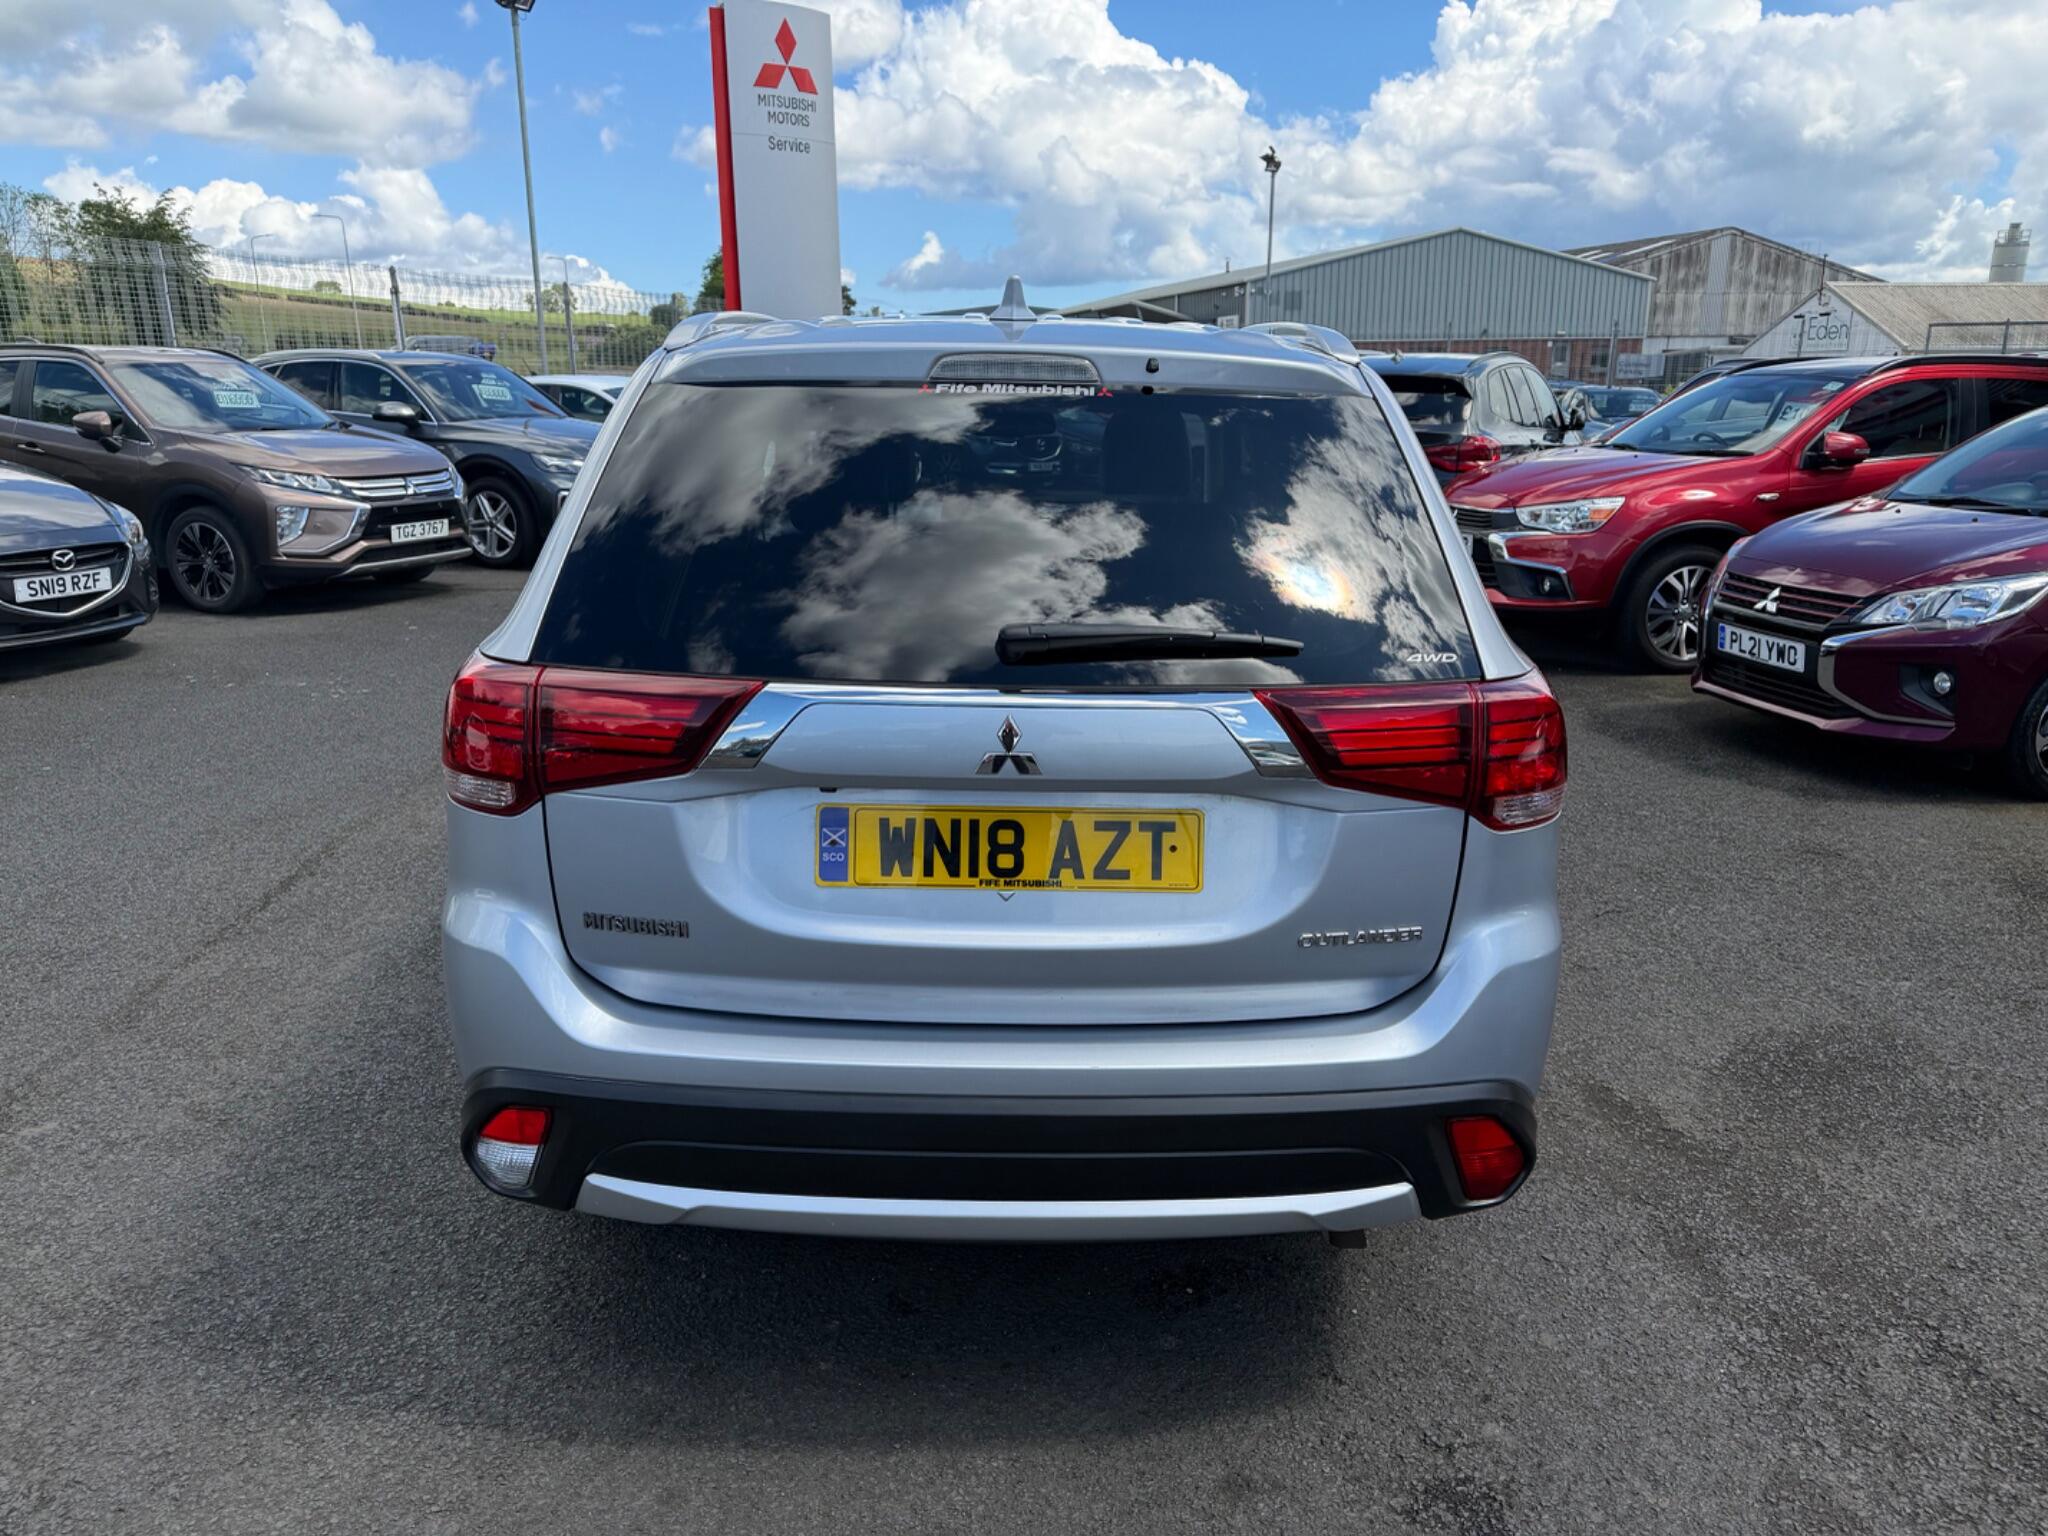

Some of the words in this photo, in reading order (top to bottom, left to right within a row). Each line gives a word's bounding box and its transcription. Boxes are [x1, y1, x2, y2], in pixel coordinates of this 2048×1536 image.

[757, 94, 817, 112] MITSUBISHI
[767, 111, 810, 127] MOTORS
[768, 135, 811, 154] Service
[1807, 314, 1851, 341] Eden
[981, 383, 1096, 397] Mitsubishi
[396, 524, 417, 539] TGZ
[419, 520, 444, 536] 3767
[26, 577, 67, 598] SN19
[71, 571, 101, 592] RZF
[1729, 631, 1762, 657] PL21
[1406, 653, 1458, 663] 4WD
[822, 852, 846, 862] SCO
[878, 816, 1026, 879] WN18
[1048, 817, 1177, 882] AZT
[979, 879, 999, 888] FIFE
[1003, 879, 1063, 889] MITSUBISHI
[583, 911, 690, 939] MITSUBISHI
[1298, 926, 1423, 947] OUTLANDER
